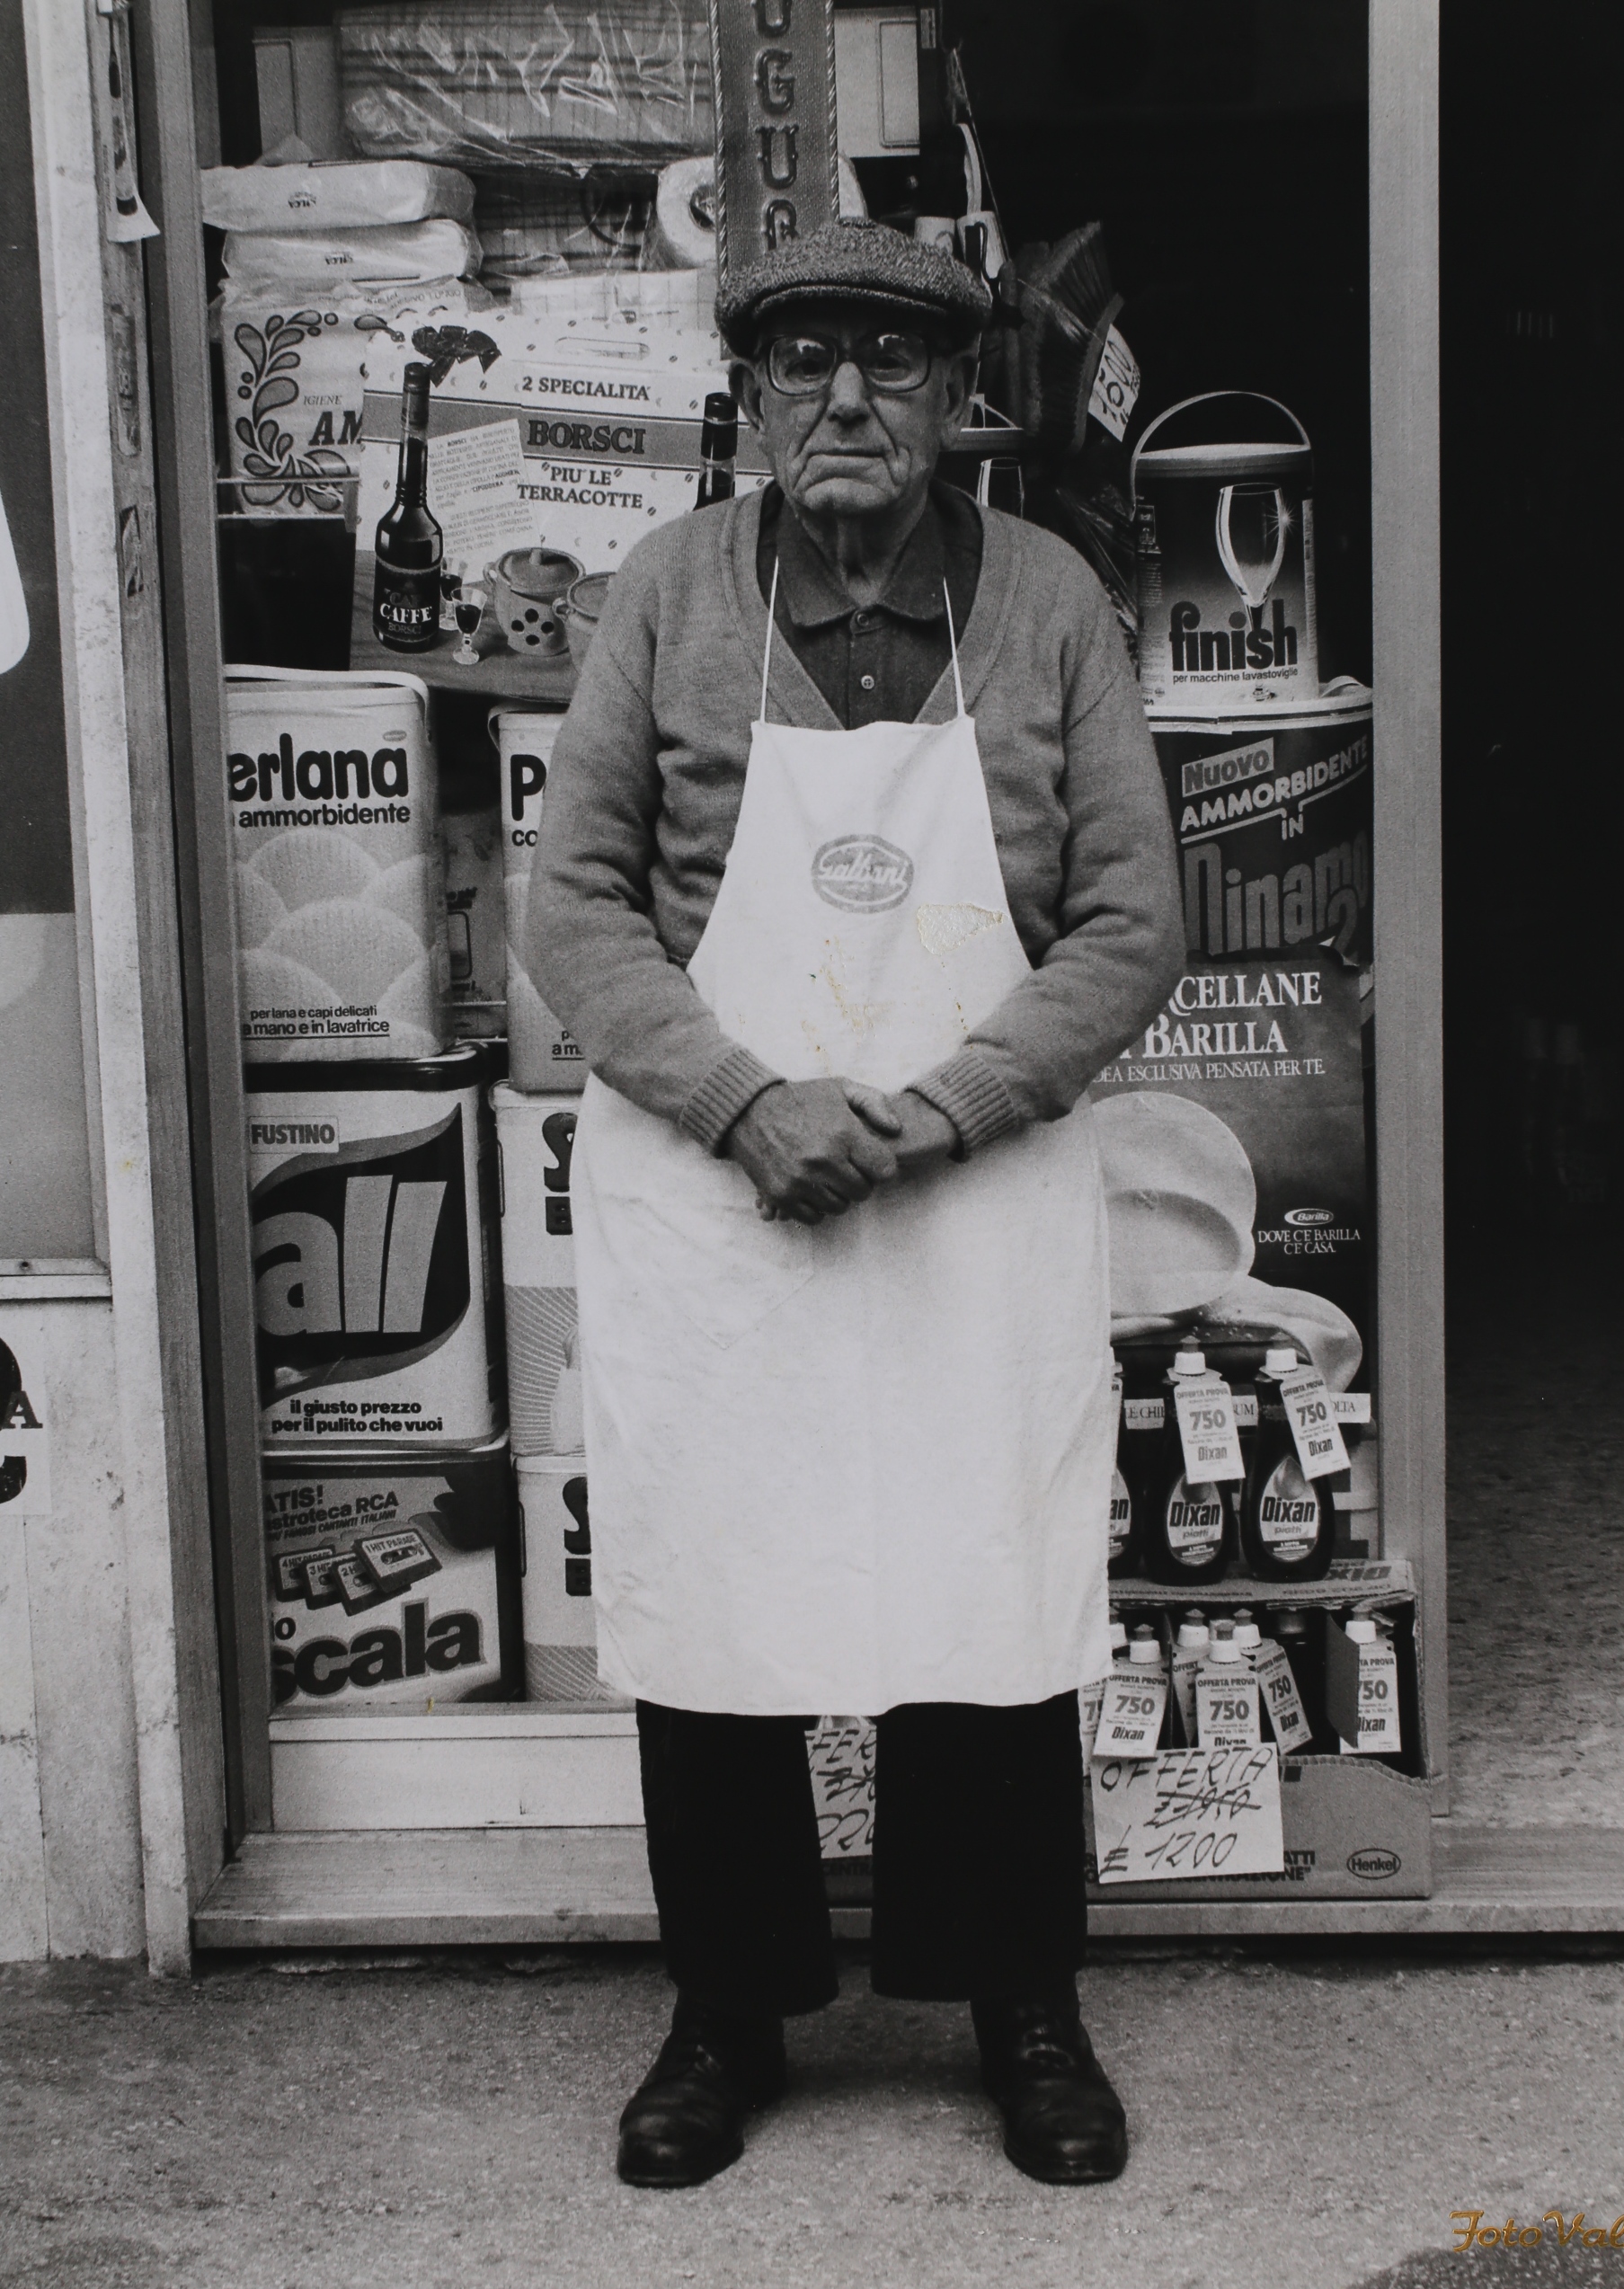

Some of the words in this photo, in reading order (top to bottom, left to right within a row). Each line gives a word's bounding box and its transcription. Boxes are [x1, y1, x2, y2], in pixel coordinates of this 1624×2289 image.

[522, 376, 532, 391] 2
[303, 395, 342, 405] IGIENE
[528, 420, 646, 455] BORSCI
[588, 469, 612, 486] LE
[517, 484, 643, 509] TERRACOTTE
[1169, 599, 1298, 672] finish
[1172, 675, 1187, 686] per
[1190, 672, 1240, 683] macchine
[1242, 667, 1299, 681] lavastoviglie
[1183, 748, 1271, 794] NUOVO
[1180, 734, 1368, 832] AMMORBIDENTE
[238, 803, 411, 828] ammorbidente
[251, 1009, 272, 1022] per
[272, 1007, 297, 1019] lana
[298, 1008, 306, 1018] e
[308, 1007, 333, 1020] capi
[334, 1005, 377, 1018] delicati
[253, 1022, 297, 1034] mano
[298, 1022, 309, 1034] e
[311, 1019, 324, 1034] in
[327, 1018, 389, 1034] lavatrice
[1142, 1013, 1289, 1059] BARILLA
[1128, 1062, 1202, 1082] ESCLUSIVA
[1206, 1059, 1270, 1078] PENSATA
[1273, 1059, 1305, 1077] PER
[251, 1123, 335, 1145] FUSTINO
[1297, 1211, 1330, 1222] Barilla
[1258, 1229, 1291, 1244] DOVE
[1314, 1229, 1361, 1241] BARILLA
[253, 1174, 448, 1336] all
[1282, 1384, 1305, 1397] OFFERTA
[290, 1399, 302, 1415] il
[304, 1399, 359, 1417] giusto
[361, 1401, 422, 1416] prezzo
[1296, 1401, 1327, 1427] 750
[271, 1419, 302, 1434] per
[304, 1417, 315, 1432] il
[316, 1417, 368, 1434] pulito
[369, 1417, 403, 1432] che
[404, 1416, 443, 1432] vuoi
[1189, 1408, 1227, 1432] 750
[1197, 1446, 1228, 1462] Dixan
[1309, 1439, 1334, 1457] Dixan
[355, 1491, 399, 1514] RCA
[1261, 1495, 1316, 1523] Dixan
[318, 1516, 359, 1533] CANTANTI
[361, 1510, 397, 1525] ITALIANI
[1169, 1502, 1221, 1527] Dixan
[371, 1541, 386, 1553] HIT
[308, 1566, 316, 1575] 3
[342, 1567, 350, 1578] 2
[1370, 1657, 1395, 1666] PROVA
[1109, 1674, 1140, 1684] OFFERTA
[1141, 1675, 1167, 1687] PROVA
[1197, 1679, 1229, 1688] OFFERTA
[1230, 1678, 1256, 1686] PROVA
[1268, 1674, 1291, 1702] 750
[1115, 1694, 1156, 1716] 750
[1209, 1699, 1250, 1721] 750
[1111, 1726, 1146, 1741] Dixan
[1100, 1746, 1273, 1792] OFFERTA
[1145, 1831, 1238, 1871] 1200
[1352, 1855, 1398, 1873] Henkel
